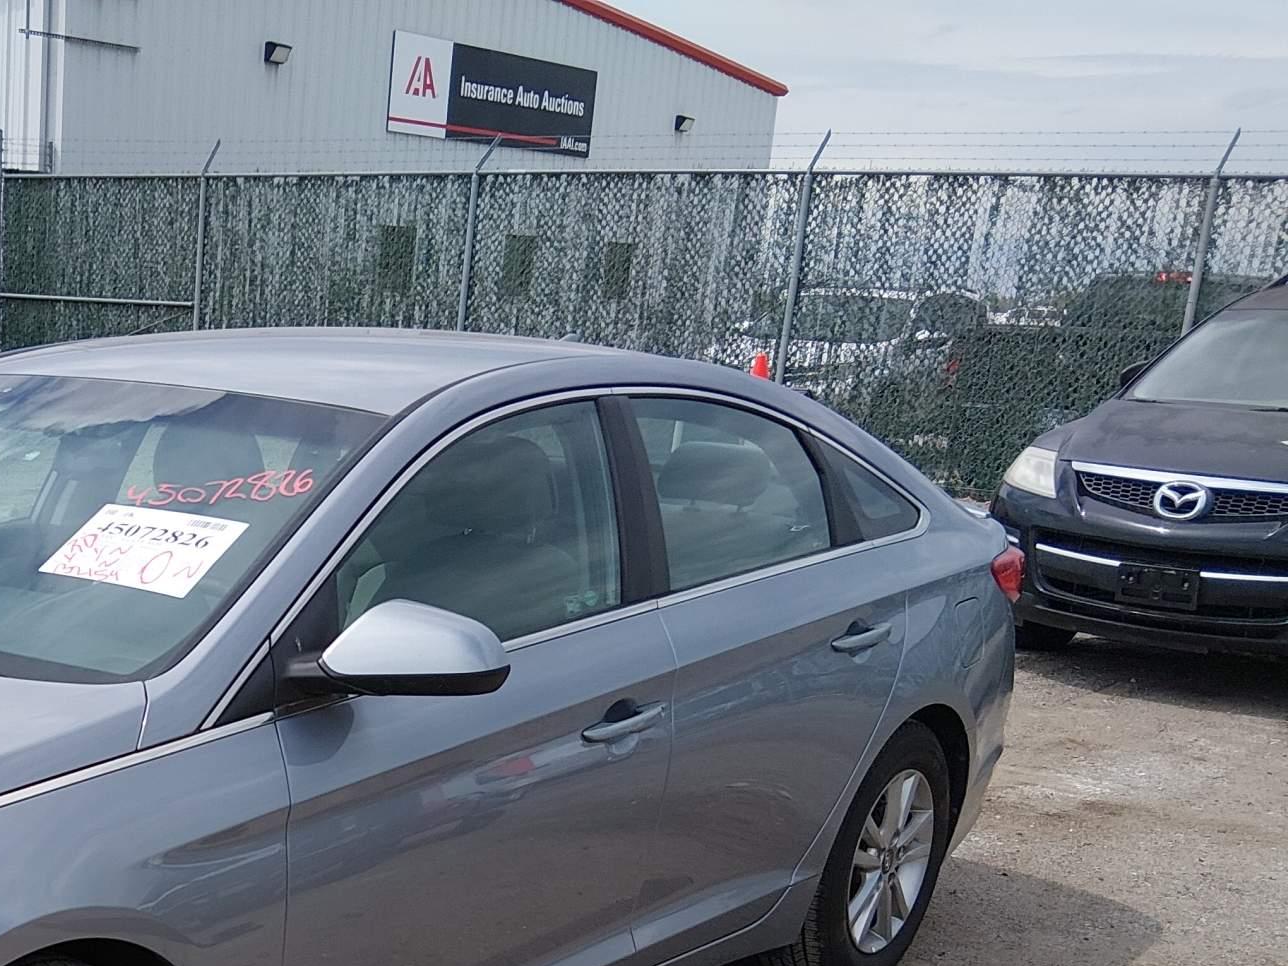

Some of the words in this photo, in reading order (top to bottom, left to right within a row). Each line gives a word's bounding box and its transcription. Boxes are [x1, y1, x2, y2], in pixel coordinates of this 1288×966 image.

[460, 75, 514, 104] Insurance
[515, 85, 540, 109] Auto
[541, 90, 585, 117] Auctions
[127, 468, 314, 506] 45072826
[97, 521, 214, 549] 45072826
